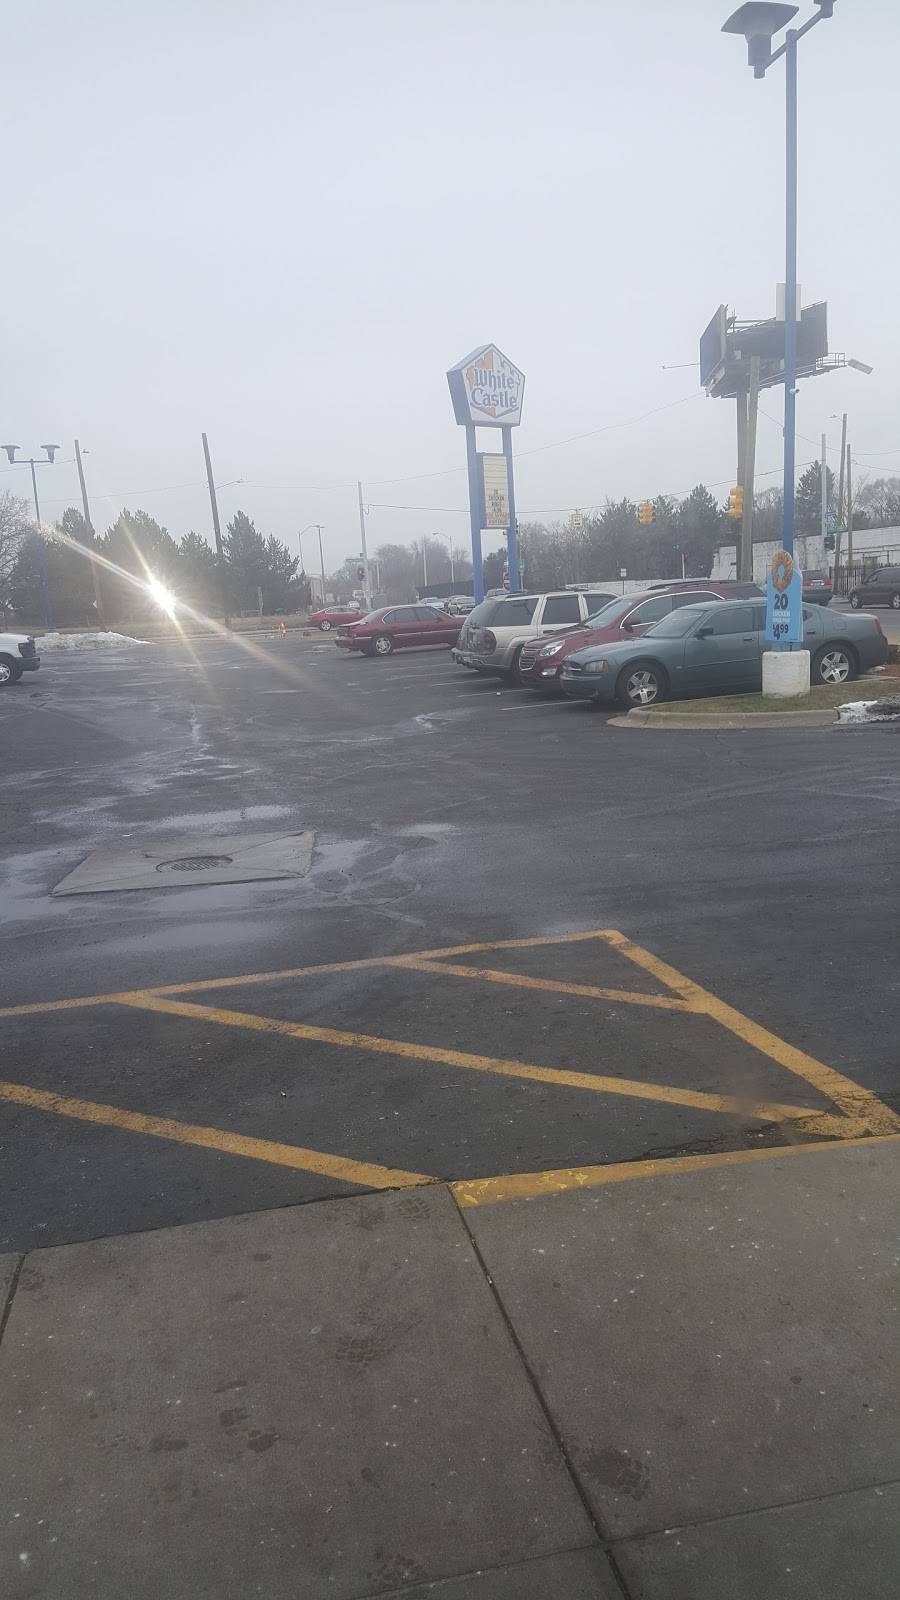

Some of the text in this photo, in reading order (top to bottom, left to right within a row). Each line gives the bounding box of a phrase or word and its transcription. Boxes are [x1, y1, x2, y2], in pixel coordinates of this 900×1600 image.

[474, 369, 515, 391] White
[471, 387, 517, 408] Castle
[774, 594, 788, 609] 20
